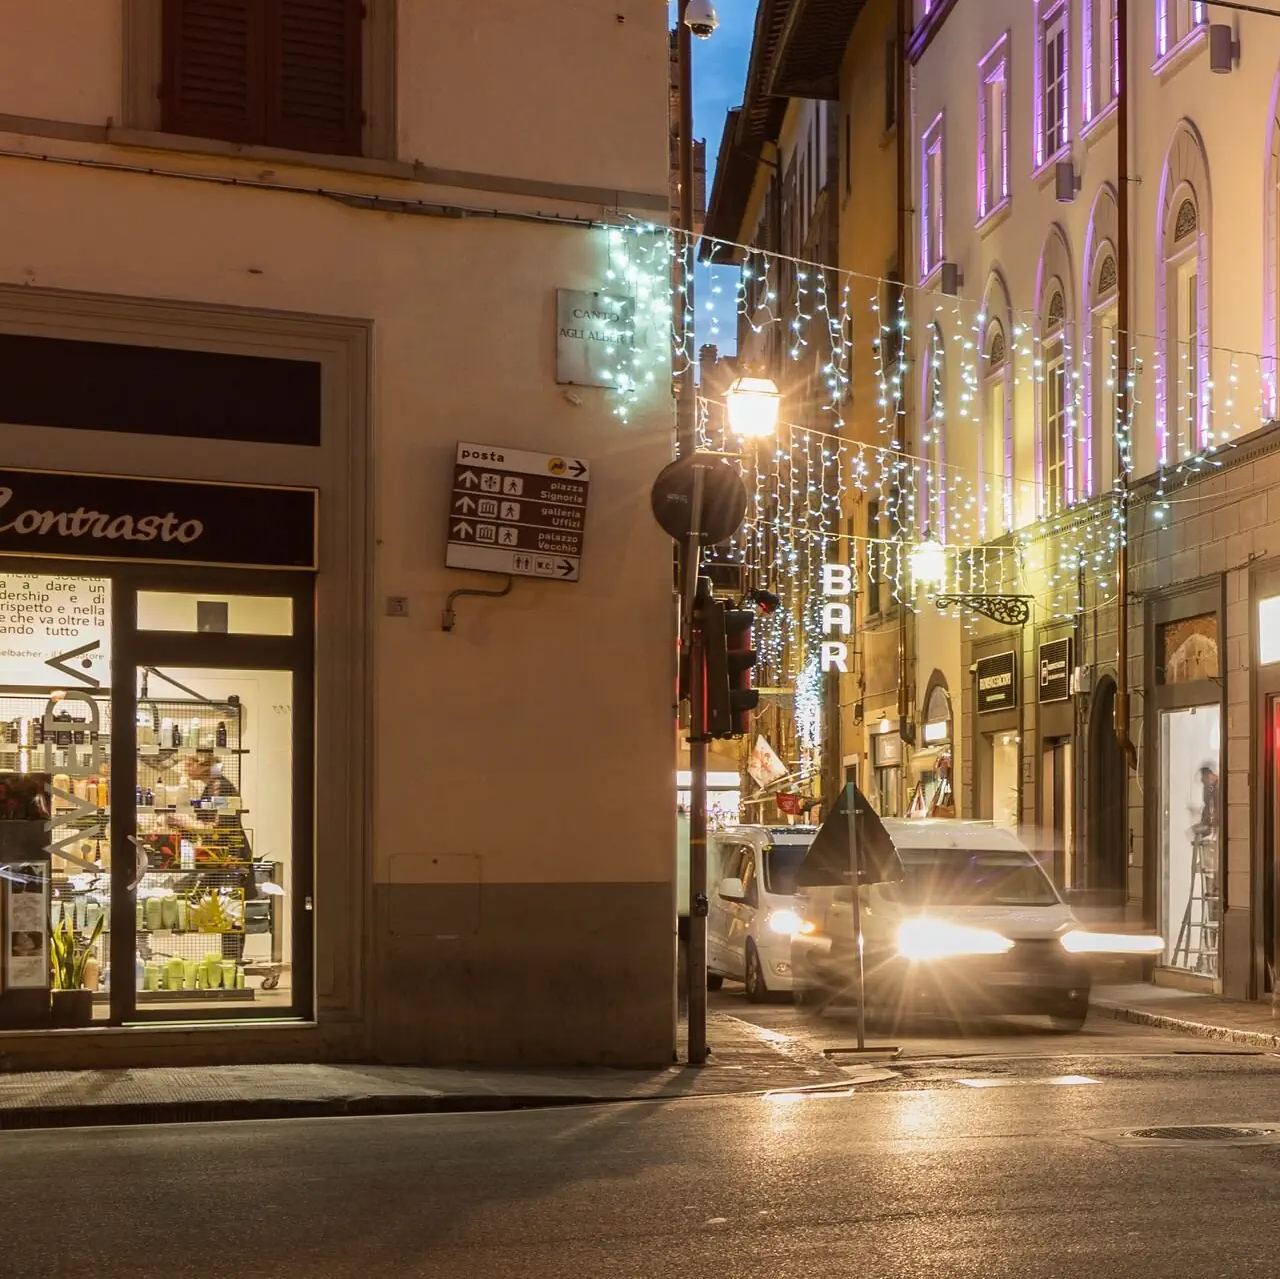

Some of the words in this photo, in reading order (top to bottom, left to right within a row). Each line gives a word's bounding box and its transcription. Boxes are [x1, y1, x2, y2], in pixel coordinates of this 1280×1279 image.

[573, 308, 620, 322] CANTO
[560, 328, 584, 339] AGLI
[462, 449, 505, 463] posta
[551, 482, 584, 493] piazza
[540, 490, 583, 503] Signoria
[542, 506, 581, 518] galleria
[552, 518, 580, 528] Uffizi
[538, 532, 578, 543] palazzo
[538, 541, 578, 553] Vecchio
[23, 582, 30, 590] a
[46, 581, 76, 592] dare
[89, 585, 105, 593] un
[0, 590, 49, 603] dership
[70, 595, 78, 603] e
[93, 594, 105, 604] di
[0, 601, 53, 614] rispetto
[57, 605, 65, 614] e
[73, 605, 105, 616] nella
[10, 614, 34, 624] che
[39, 616, 54, 625] va
[58, 615, 90, 626] oltre
[94, 616, 105, 627] la
[821, 563, 852, 673] BAR
[46, 627, 79, 637] tutto
